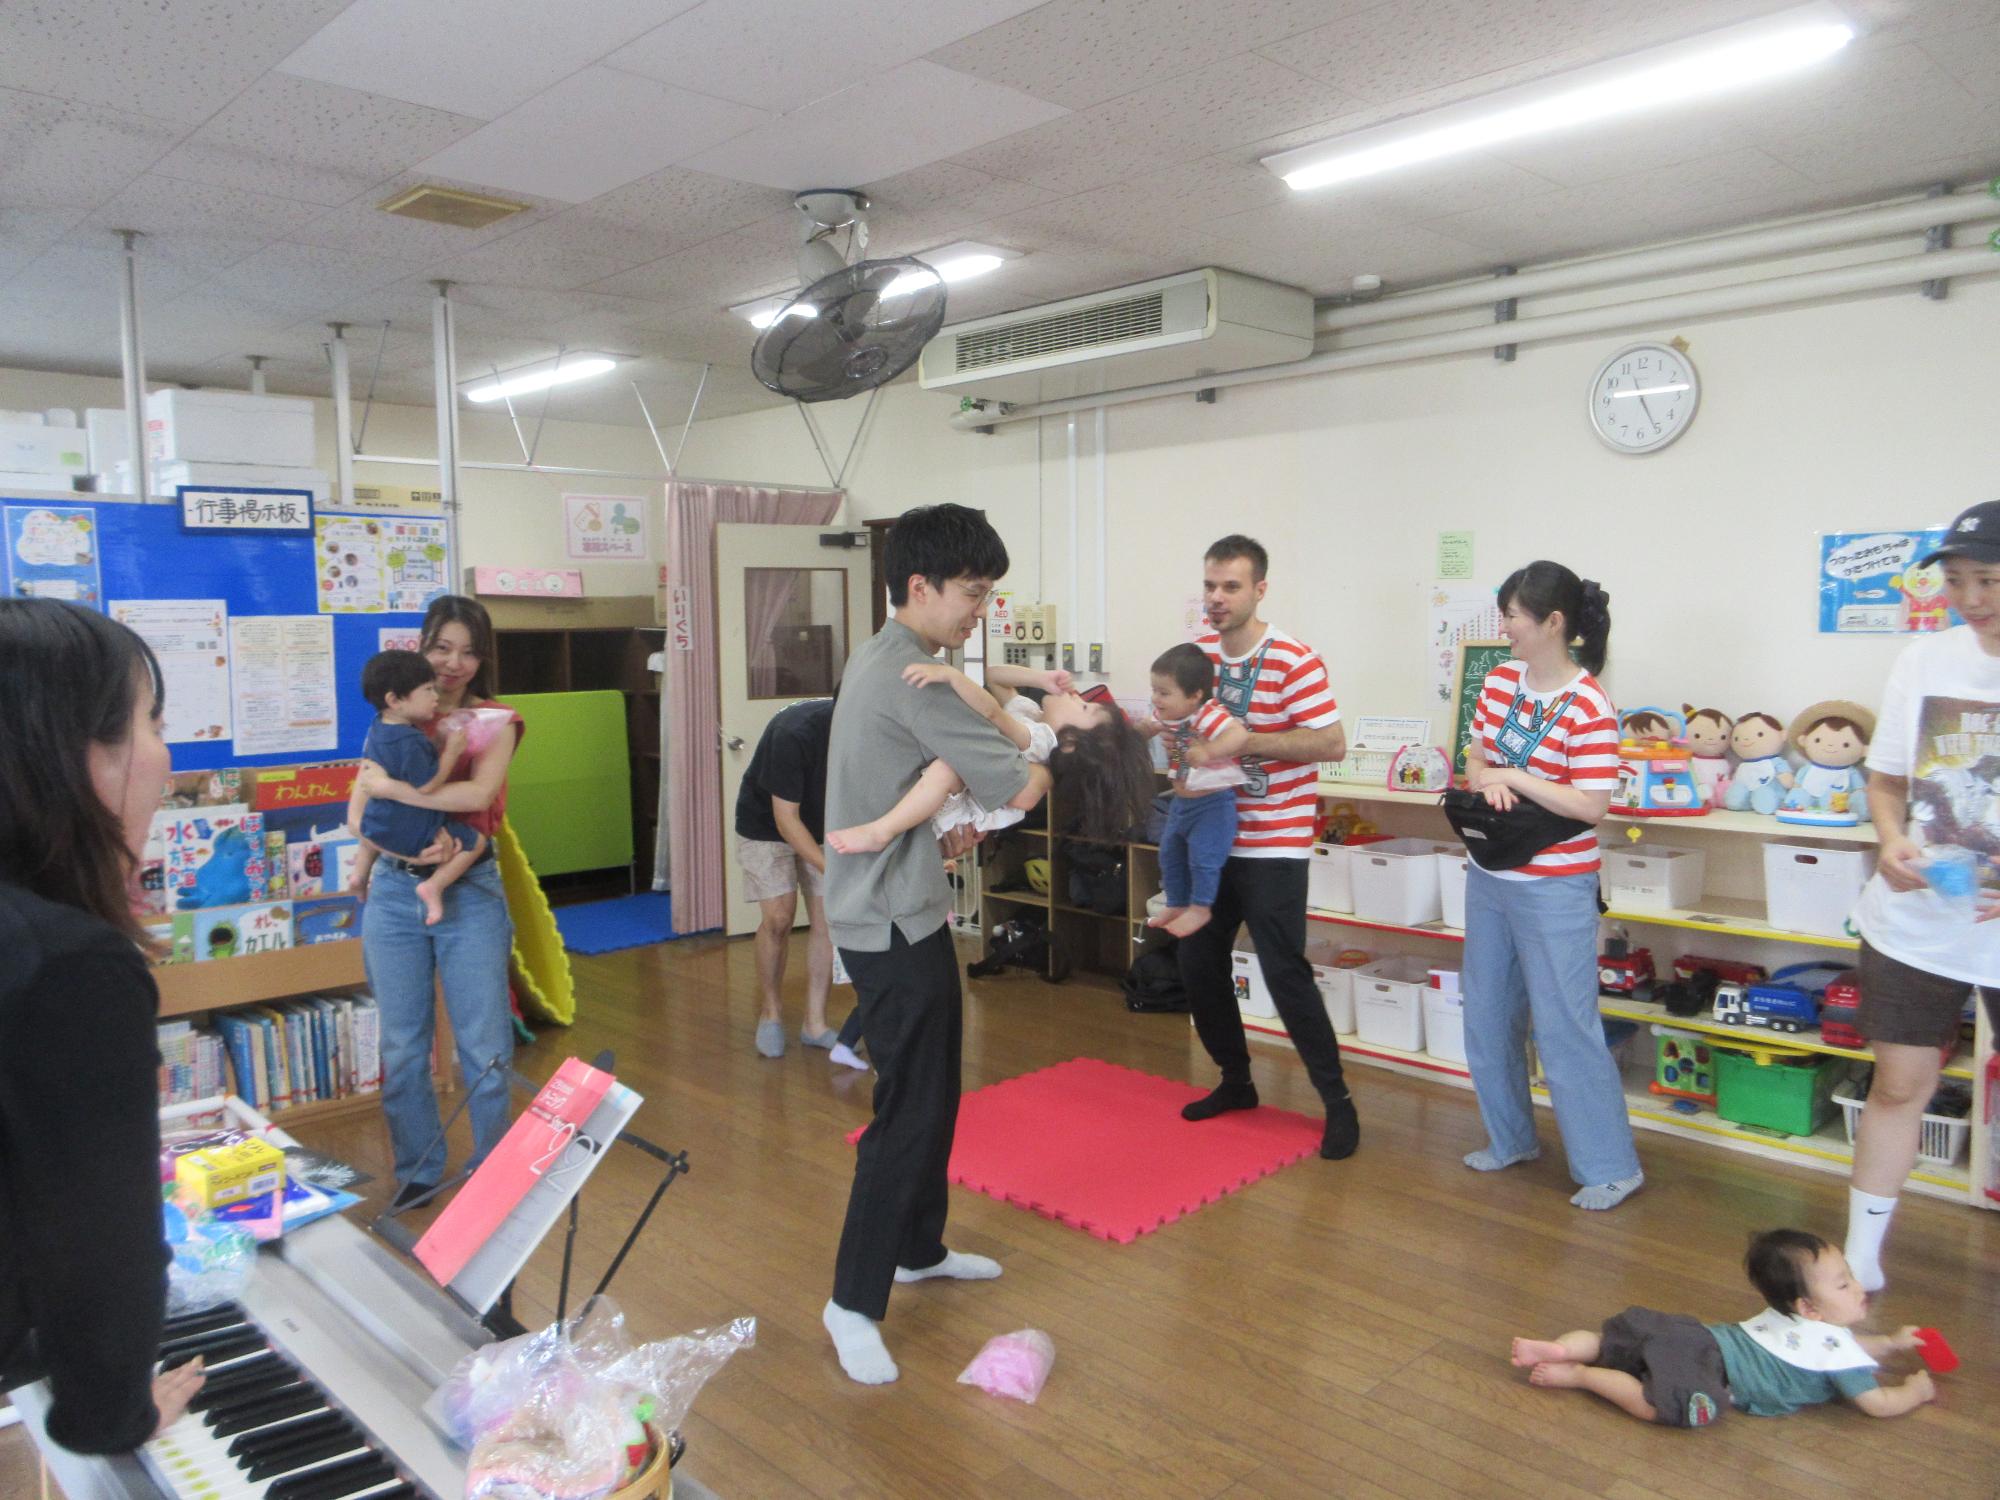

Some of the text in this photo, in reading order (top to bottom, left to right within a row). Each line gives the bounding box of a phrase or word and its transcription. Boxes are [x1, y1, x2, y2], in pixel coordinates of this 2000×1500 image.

[673, 589, 689, 648] いりぐち
[994, 610, 1008, 618] AED
